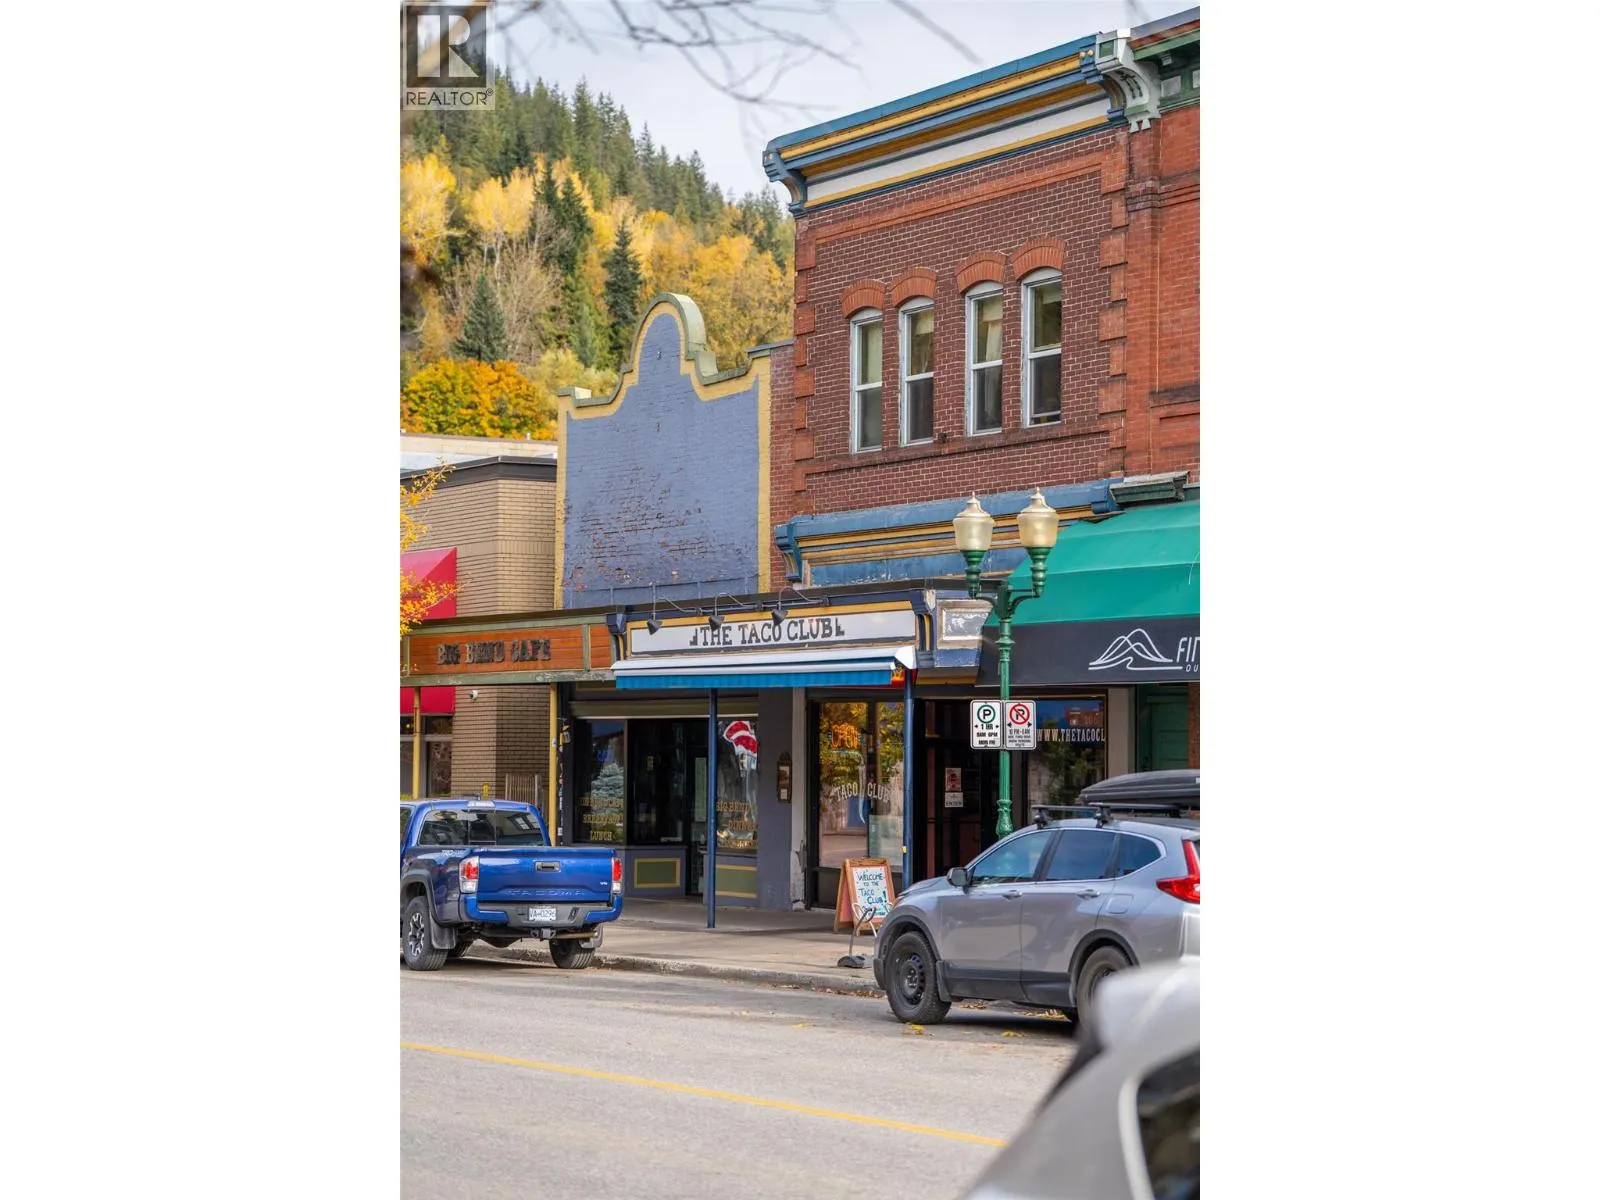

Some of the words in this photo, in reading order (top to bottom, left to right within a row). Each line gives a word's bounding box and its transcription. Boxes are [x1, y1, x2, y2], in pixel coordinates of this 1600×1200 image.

[700, 625, 733, 646] THE
[738, 622, 782, 645] TACO
[787, 617, 833, 641] CLUB
[836, 781, 858, 801] TACO
[867, 782, 890, 803] CLUB
[856, 870, 884, 881] WELCOME
[858, 887, 875, 897] TACO
